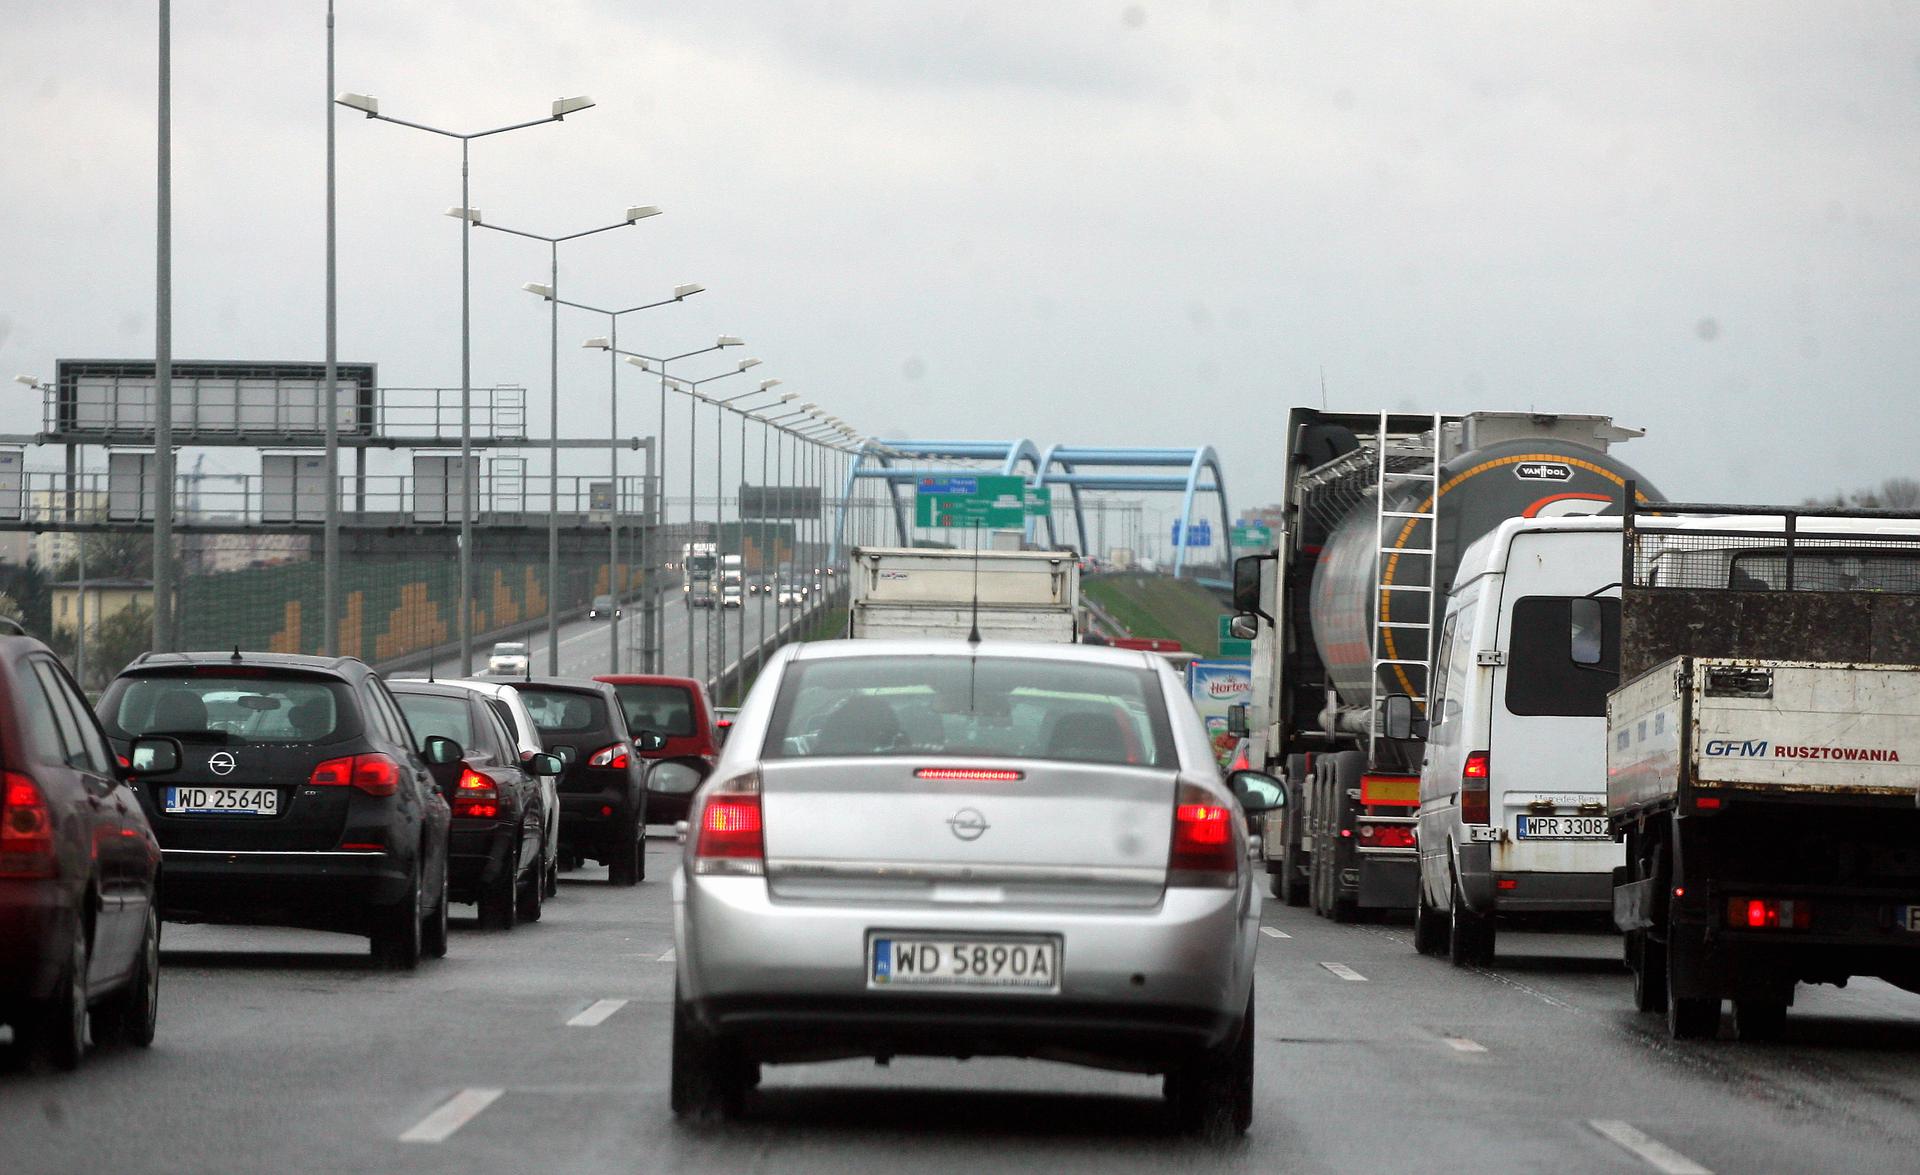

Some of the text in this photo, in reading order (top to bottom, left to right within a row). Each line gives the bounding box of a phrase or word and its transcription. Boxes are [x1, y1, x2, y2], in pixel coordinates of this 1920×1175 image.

[1211, 682, 1249, 694] Hortex
[1705, 740, 1900, 762] GFM RUSZTOWANIA
[179, 789, 275, 809] WD 2564G
[1527, 818, 1558, 835] WPR
[897, 945, 1048, 976] WD 5890A
